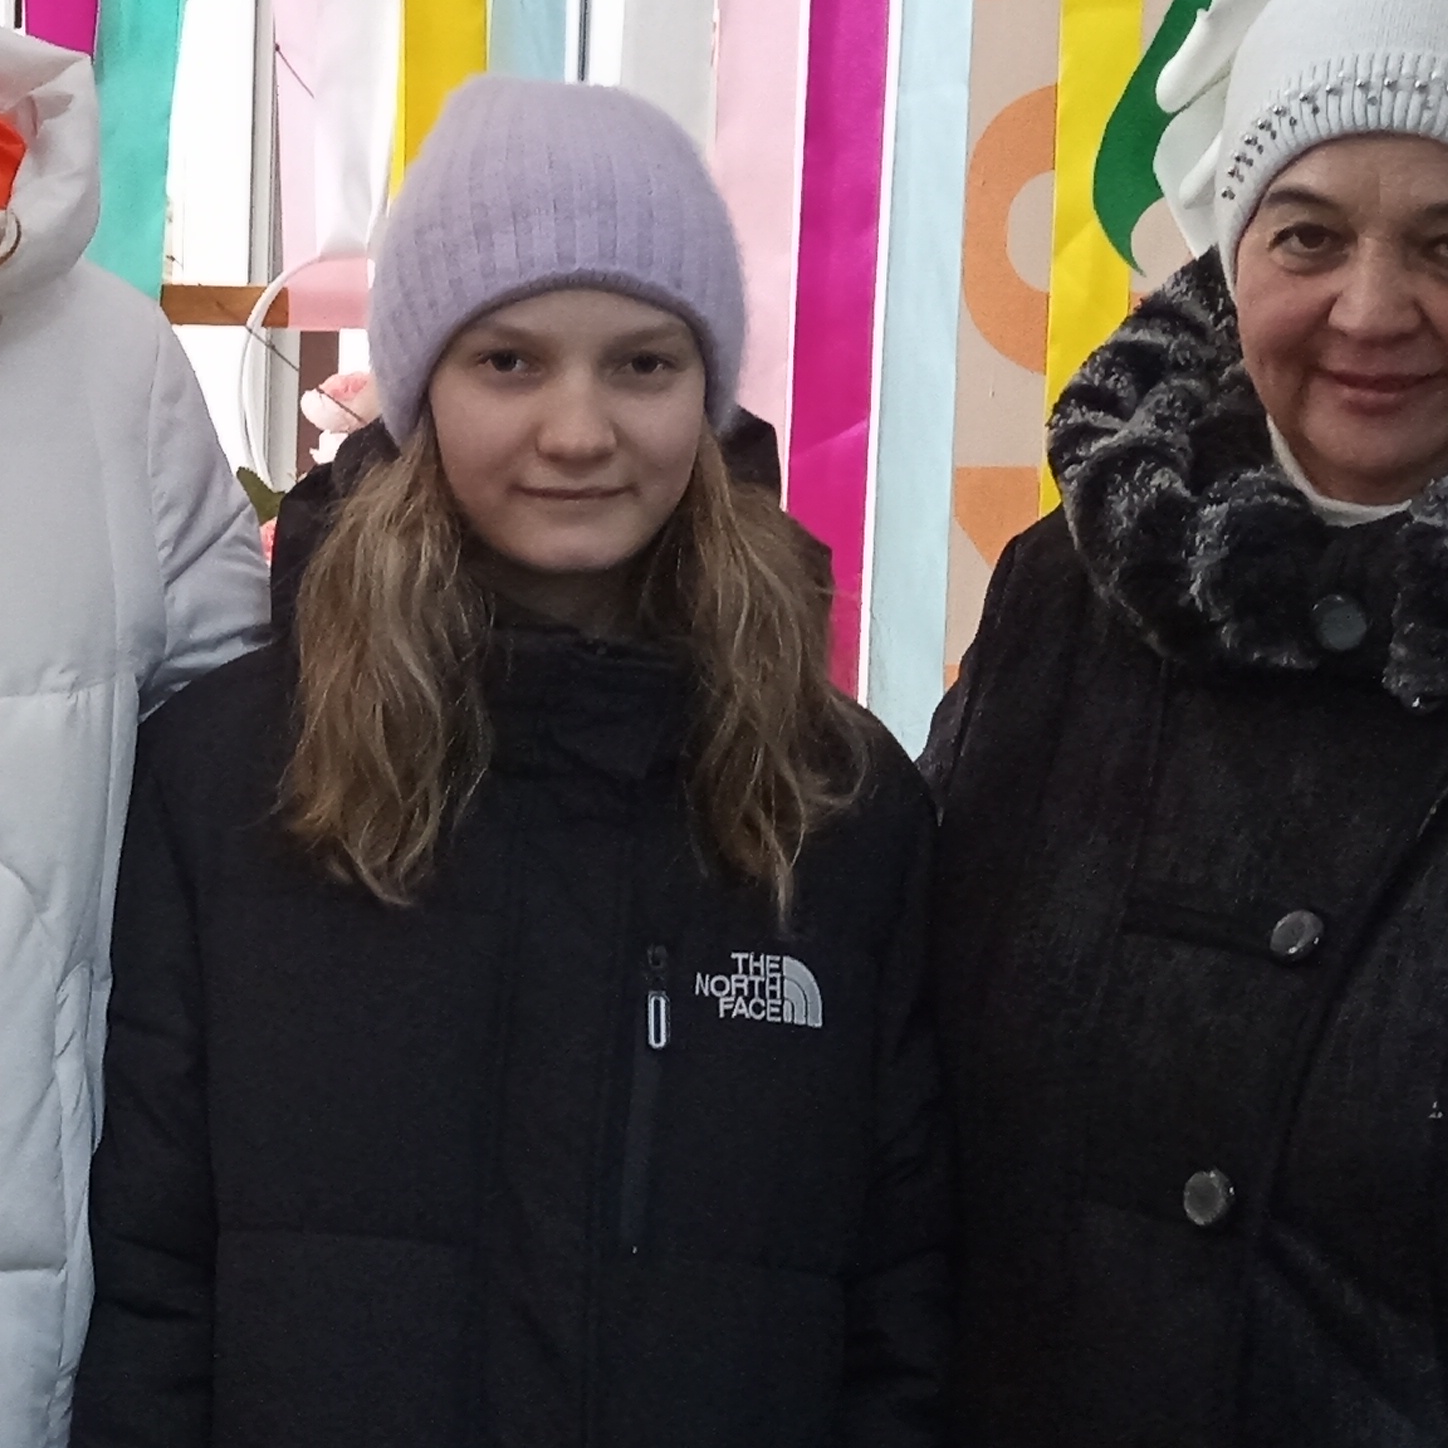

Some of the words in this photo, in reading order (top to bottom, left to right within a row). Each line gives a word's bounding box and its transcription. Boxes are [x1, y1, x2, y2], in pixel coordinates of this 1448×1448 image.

[730, 951, 781, 978] THE
[694, 972, 781, 999] NORTH
[718, 996, 782, 1022] FACE
